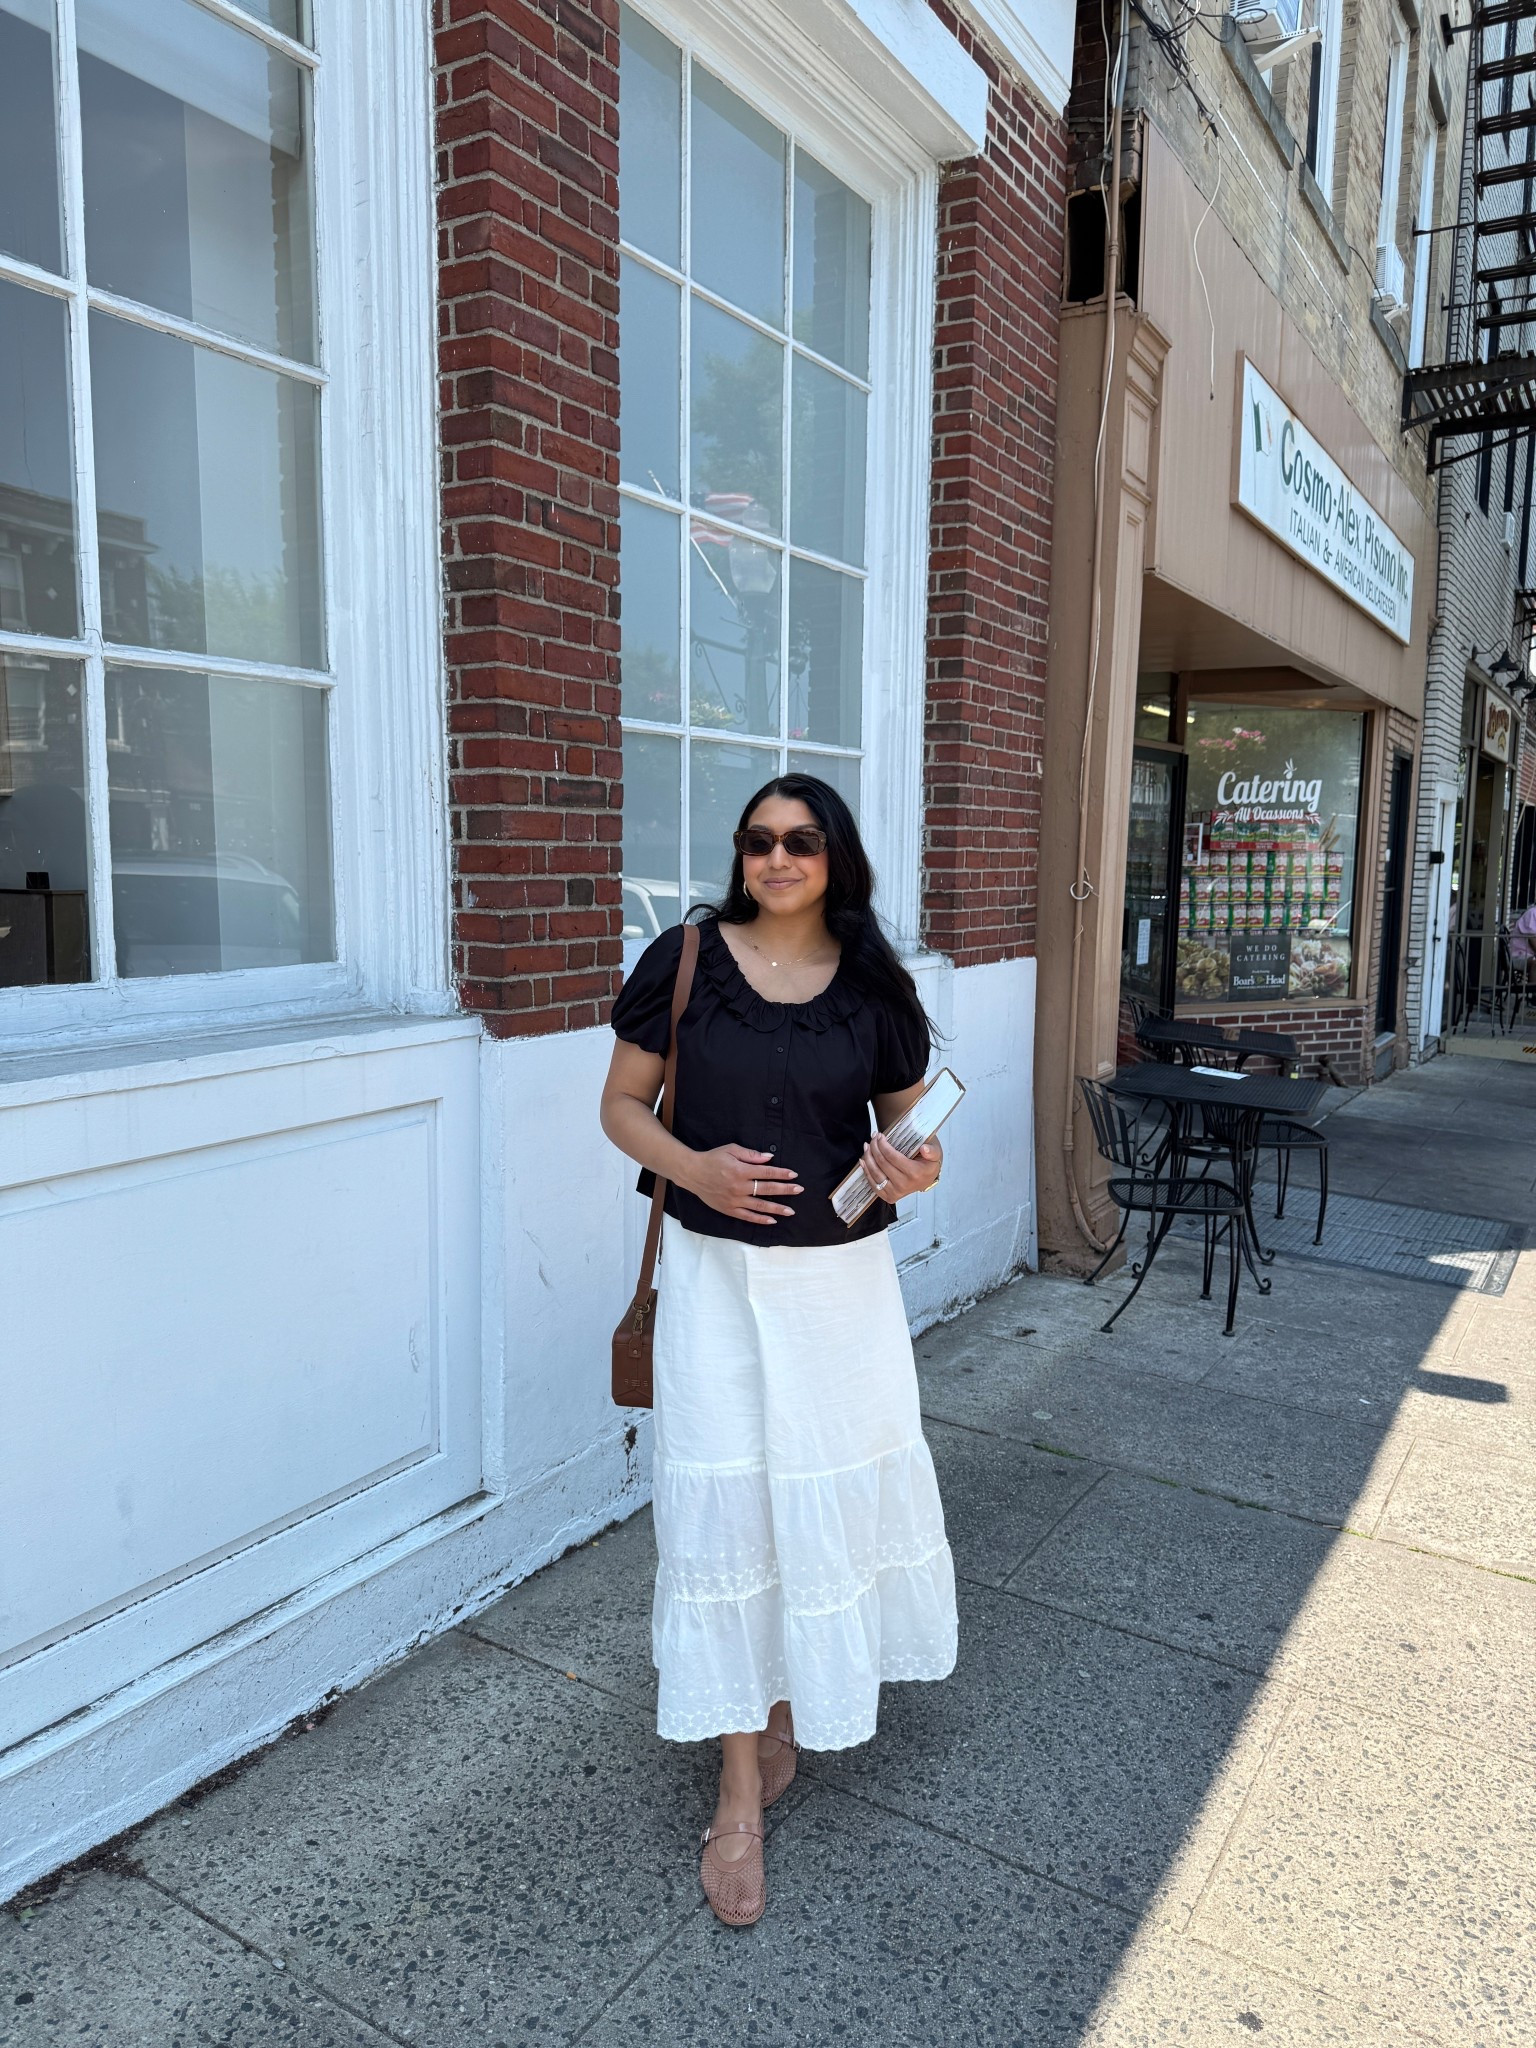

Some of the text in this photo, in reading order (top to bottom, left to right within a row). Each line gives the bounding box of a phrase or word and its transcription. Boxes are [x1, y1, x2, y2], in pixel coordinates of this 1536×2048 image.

[1289, 507, 1397, 622] ITALIAN & AMERICAN DELICATESSEN
[1364, 514, 1397, 588] Pisano
[1396, 551, 1409, 601] Inc.
[1217, 770, 1322, 813] Catering
[1234, 806, 1304, 823] All Ocassions
[1264, 944, 1277, 952] DO
[1236, 953, 1285, 962] CATERING
[1233, 974, 1286, 986] Boar's Head
